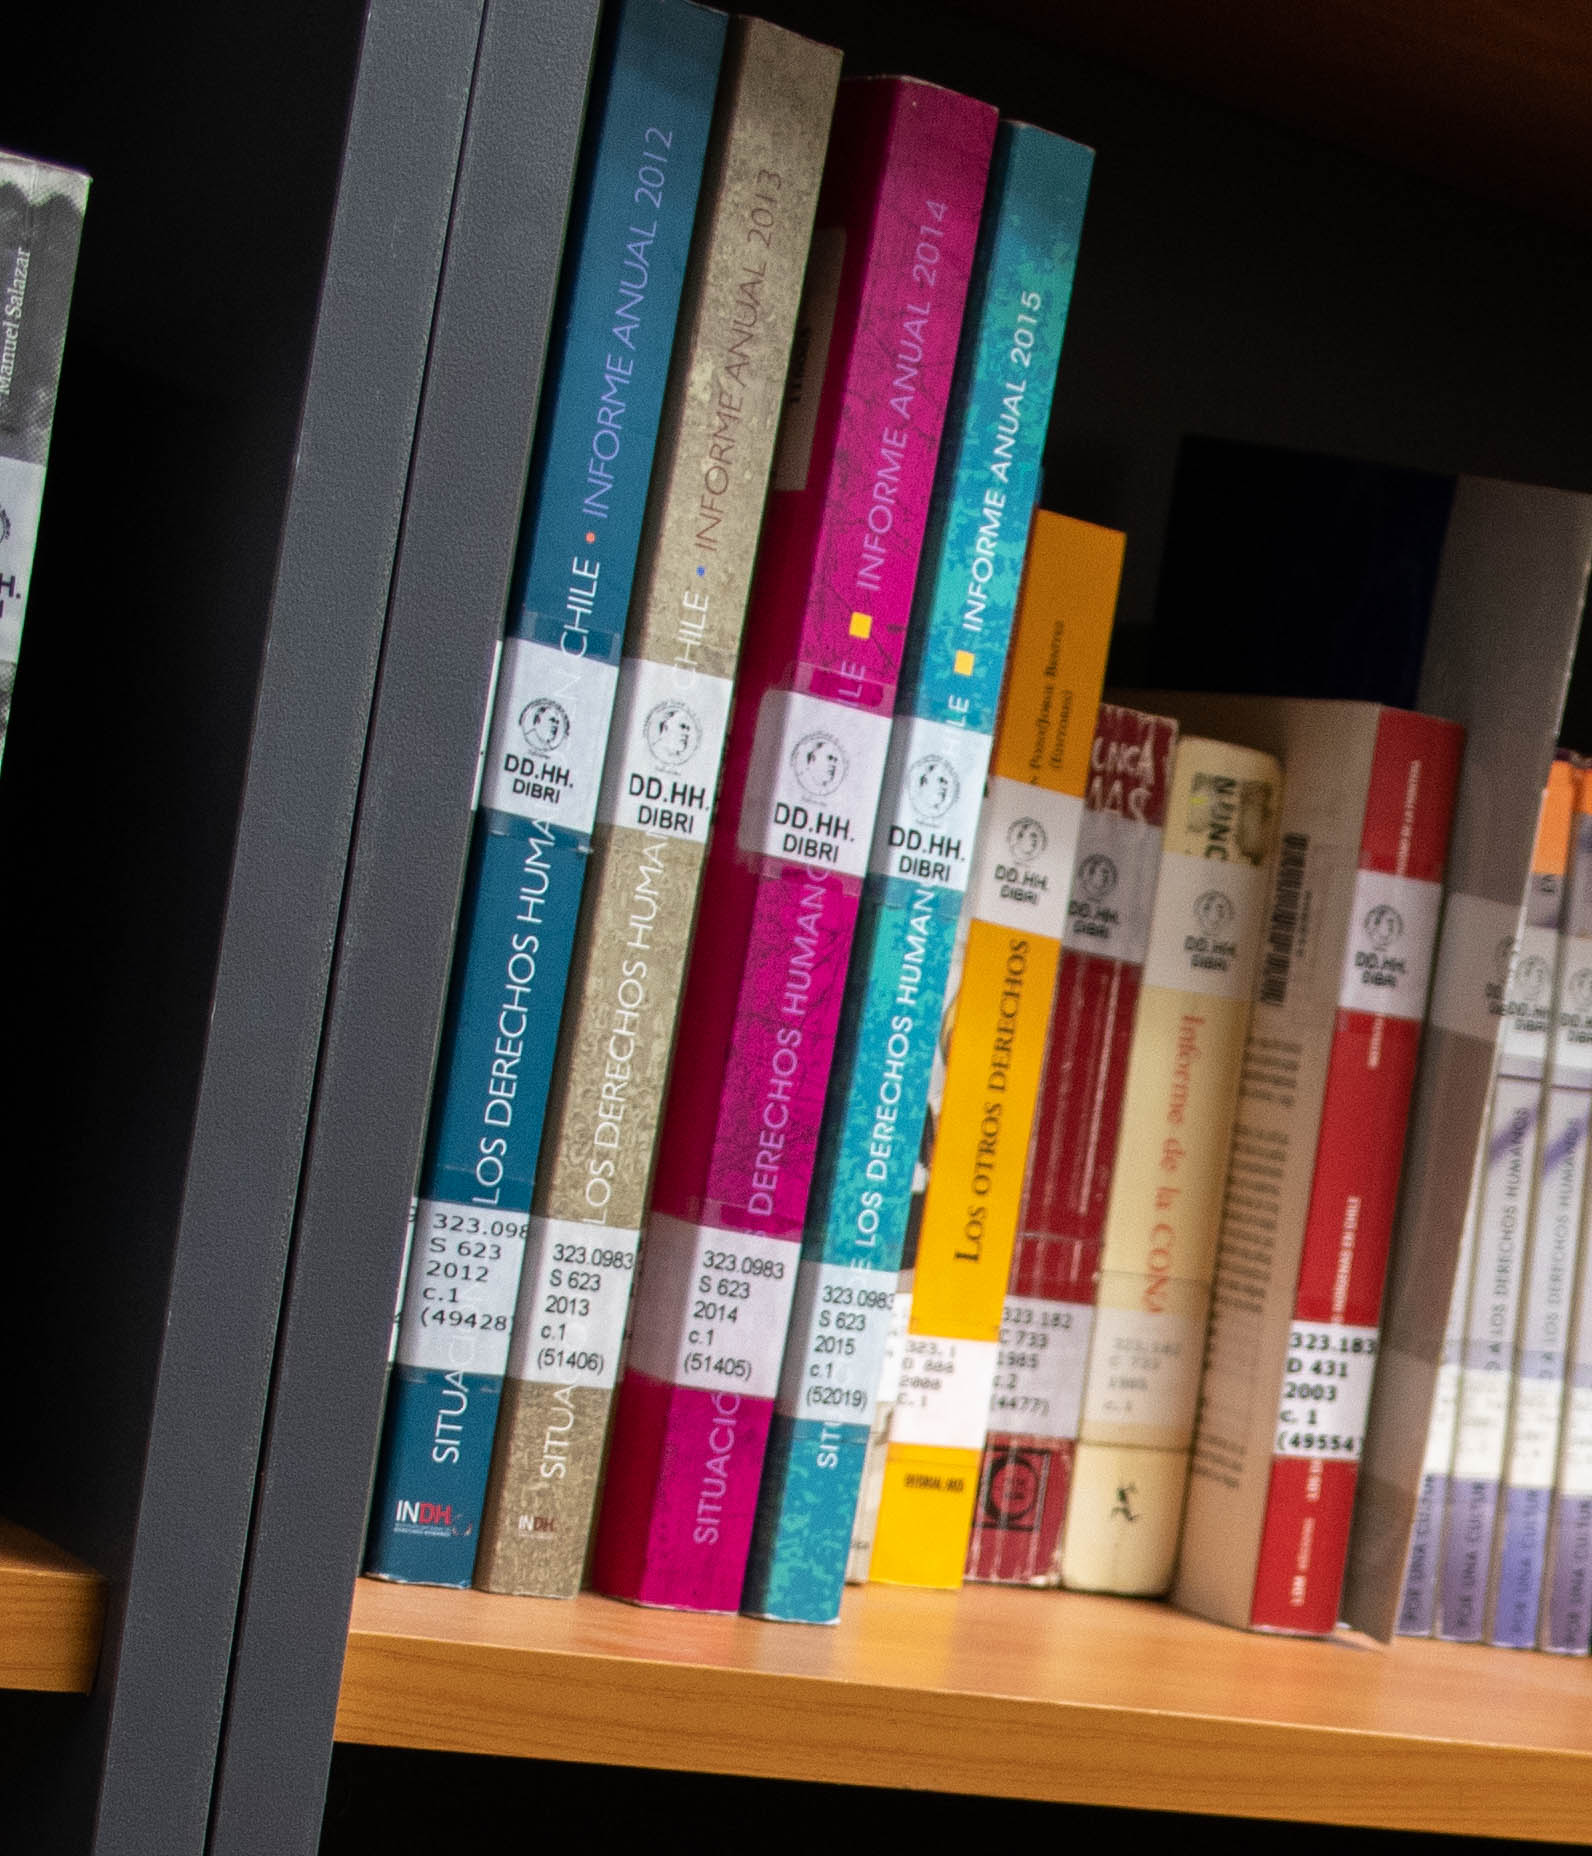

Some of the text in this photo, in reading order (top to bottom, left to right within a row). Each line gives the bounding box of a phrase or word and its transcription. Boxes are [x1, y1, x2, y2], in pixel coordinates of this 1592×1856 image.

[745, 167, 783, 247] 2013
[6, 247, 30, 317] Salazar
[717, 259, 767, 386] ANUAL
[560, 128, 673, 658] CHILE INFORME ANUAL 2012
[856, 199, 949, 591] INFORME ANUAL 2014
[695, 392, 743, 553] INFORME
[961, 292, 1042, 631] INFORME ANUAL 2015
[504, 754, 574, 788] DD.HH.
[512, 779, 561, 804] DIBRI
[628, 774, 710, 811] DD.HH.
[638, 805, 694, 833] DIBRI
[774, 802, 855, 843] DD.HH.
[1203, 775, 1237, 862] NUNC
[783, 834, 839, 863] DIBRI
[889, 825, 966, 862] DD.HH.
[899, 856, 951, 882] DIBRI
[855, 885, 934, 1247] LOS DERECHOS HUMAN
[1167, 1014, 1206, 1125] Informe
[954, 936, 1031, 1266] LOS OTROS DERECHOS
[432, 814, 558, 1464] SITUA LOS DERECHOS HUMA
[541, 833, 669, 1479] SITUA LOS DERECHOS HUMA
[1160, 1137, 1186, 1173] de
[694, 866, 831, 1545] SITUACIÓ DERECHOS HUMANO
[430, 1237, 502, 1260] S 623
[553, 1244, 635, 1270] 323.0983
[426, 1262, 489, 1283] 2012
[703, 1251, 784, 1279] 323.0983
[549, 1269, 601, 1291] S 623
[699, 1276, 750, 1299] S 623
[423, 1287, 460, 1303] c.1
[545, 1295, 590, 1316] 2013
[693, 1301, 739, 1323] 2014
[818, 1312, 866, 1331] S 623
[541, 1323, 566, 1340] c.1
[688, 1328, 715, 1345] c.1
[814, 1335, 856, 1356] 2015
[1290, 1331, 1377, 1356] 323.183
[537, 1348, 605, 1375] (51406)
[684, 1353, 751, 1382] (51405)
[810, 1362, 834, 1378] c.1
[1311, 1360, 1349, 1377] 431
[806, 1386, 869, 1410] (52019)
[1285, 1382, 1337, 1402] 2003
[395, 1500, 452, 1526] INDH
